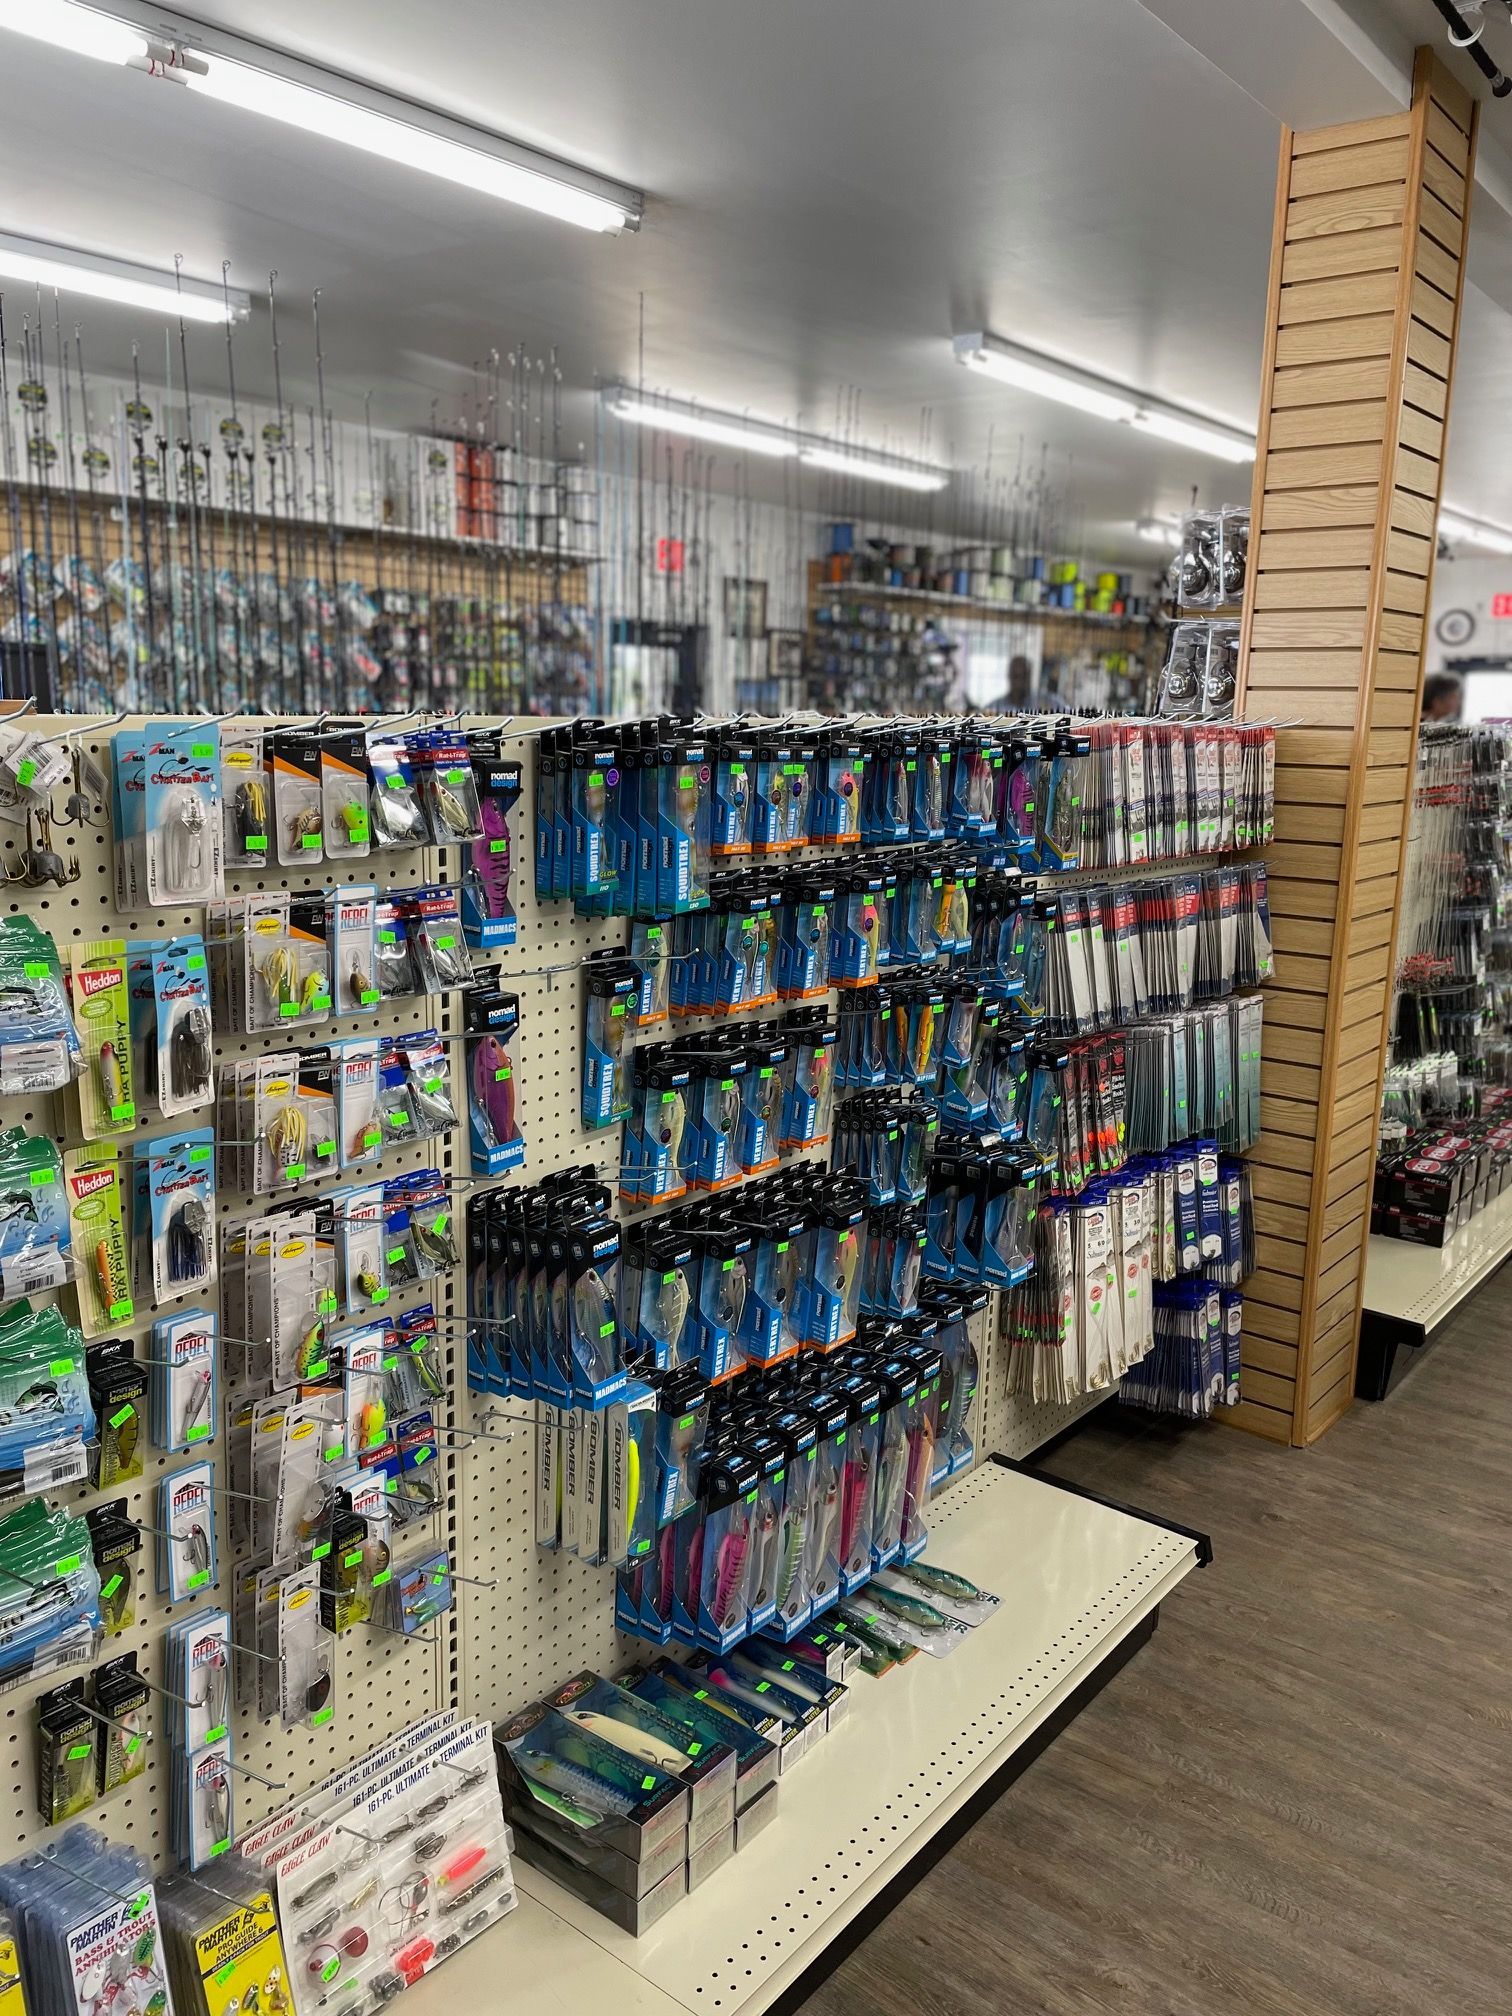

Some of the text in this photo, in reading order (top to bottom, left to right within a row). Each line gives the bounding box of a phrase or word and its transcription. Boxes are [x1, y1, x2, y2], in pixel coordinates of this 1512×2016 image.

[595, 751, 614, 759] nomad
[686, 748, 704, 757] nomad
[491, 771, 517, 780] nomad
[491, 778, 517, 788] design
[727, 811, 735, 843] VERTREX
[787, 808, 796, 837] VERTREX
[590, 832, 599, 882] SQUIDTREX
[678, 839, 689, 901] SQUIDTREX
[751, 897, 767, 905] nomad
[484, 922, 516, 936] MADMACS
[805, 955, 814, 988] VERTREX
[859, 944, 867, 977] VERTREX
[85, 973, 121, 993] Heddon
[615, 978, 633, 987] nomad
[642, 978, 652, 1014] VERTREX
[732, 968, 744, 1003] VERTREX
[488, 1005, 516, 1018] nomad
[489, 1013, 516, 1025] design
[117, 1021, 128, 1075] PUPPY
[672, 1072, 689, 1081] nomad
[731, 1061, 746, 1070] nomad
[600, 1062, 614, 1117] SQUIDTREX
[805, 1104, 815, 1138] VERTREX
[490, 1145, 523, 1164] MADMACS
[754, 1126, 764, 1163] VERTREX
[714, 1141, 725, 1179] VERTREX
[78, 1173, 112, 1196] Heddon
[593, 1234, 619, 1253] nomad
[675, 1250, 692, 1260] nomad
[768, 1318, 779, 1358] VERTREX
[829, 1304, 839, 1343] VERTREX
[715, 1336, 726, 1377] VERTREX
[109, 1387, 142, 1403] design
[595, 1378, 627, 1398] MADMACS
[686, 1394, 704, 1405] nomad
[861, 1391, 880, 1407] nomad
[828, 1411, 847, 1427] nomad
[544, 1410, 552, 1492] BOMBER
[797, 1428, 816, 1446] nomad
[568, 1416, 577, 1497] BOMBER
[588, 1422, 597, 1505] BOMBER
[765, 1452, 785, 1469] nomad
[739, 1471, 758, 1488] nomad
[663, 1471, 679, 1519] SQUIDTREX
[617, 1610, 638, 1625] nomad
[640, 1618, 661, 1634] nomad
[673, 1623, 694, 1636] nomad
[698, 1627, 720, 1643] nomad
[334, 1712, 455, 1797] 161-PC. ULTIMATE TERMINAL KIT
[381, 1757, 415, 1787] ULTIMATE
[424, 1731, 458, 1756] TERMINAL
[460, 1721, 473, 1733] KIT
[694, 1744, 723, 1768] SURFACE
[368, 1726, 488, 1814] 161-PC. ULTIMATE TERMINAL KIT
[643, 1781, 674, 1807] SURFACE
[245, 1814, 297, 1856] EAGLE CLAW
[265, 1825, 316, 1868] EAGLE CLAW
[281, 1833, 331, 1877] EAGLE CLAW
[71, 1912, 118, 1948] PANTHER
[75, 1911, 152, 1966] BASS & TROUT
[76, 1921, 115, 1953] MARTIN
[199, 1916, 240, 1949] PANTHER
[204, 1924, 238, 1953] MARTIN
[218, 1922, 257, 1953] PRO GUIDE
[216, 1930, 257, 1962] ANYWHERE
